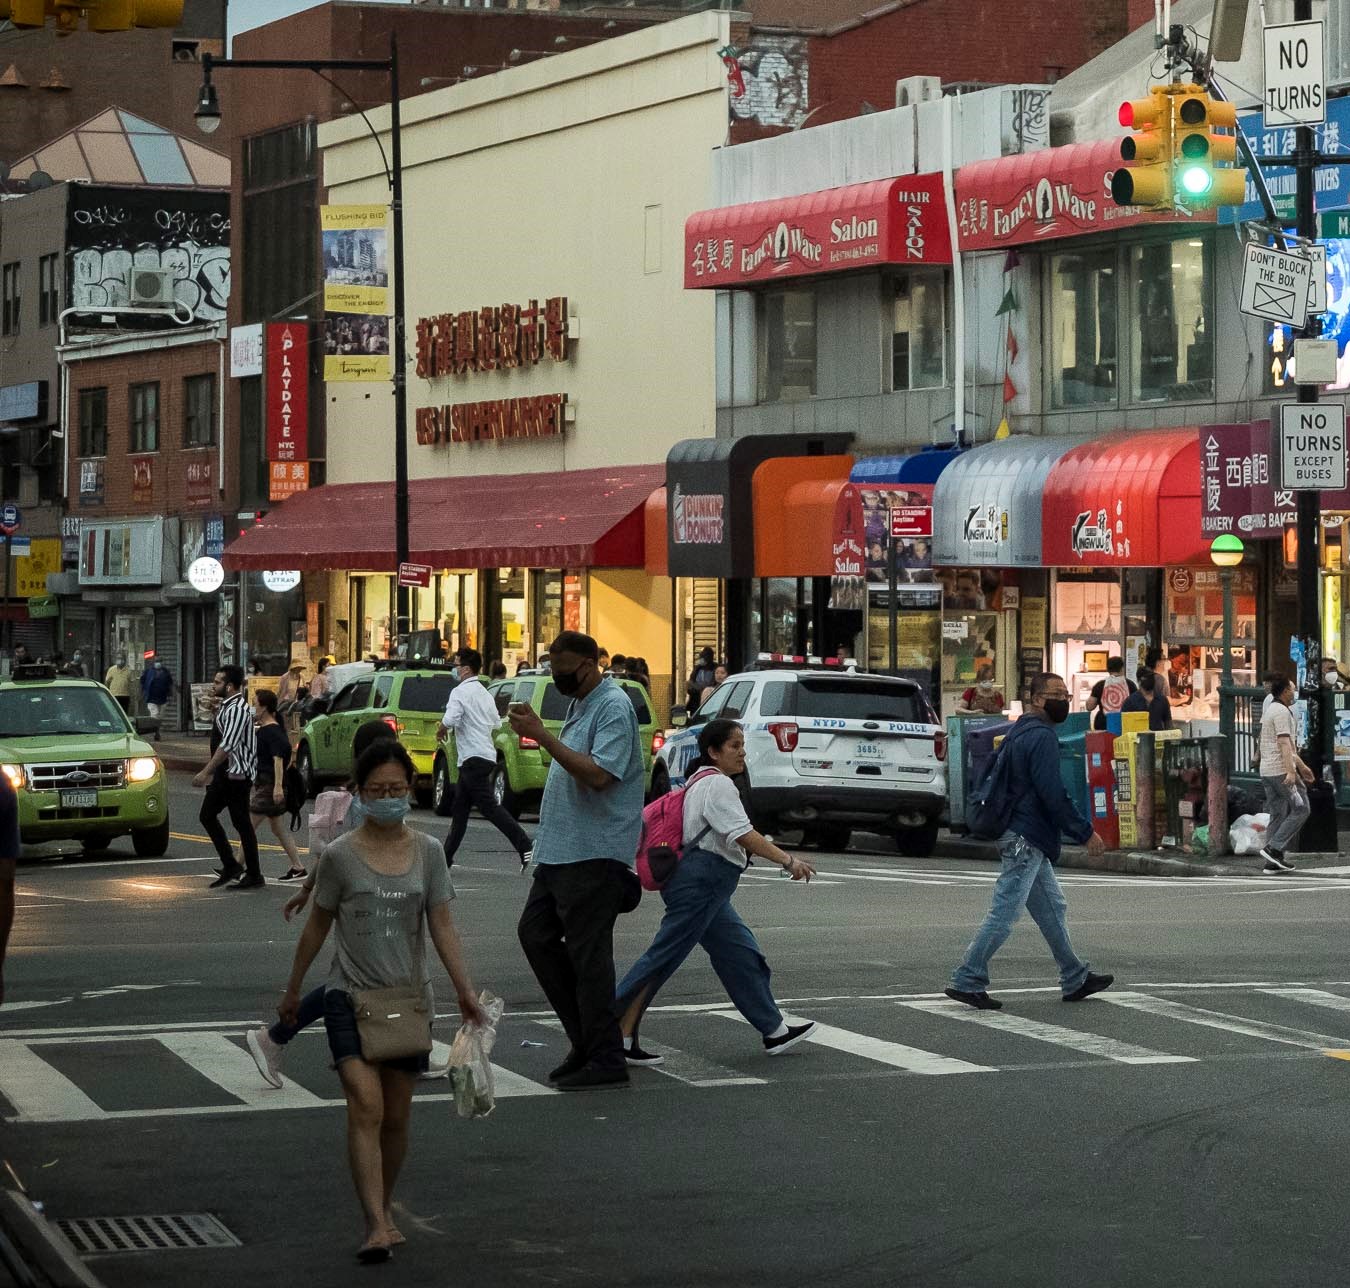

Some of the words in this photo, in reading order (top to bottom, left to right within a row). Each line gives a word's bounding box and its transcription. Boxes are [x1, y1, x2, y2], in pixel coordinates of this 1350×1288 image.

[1280, 38, 1308, 70] NO
[1268, 83, 1321, 112] TURNS
[898, 191, 930, 204] HAIR
[325, 213, 367, 221] FLUSHING
[993, 188, 1034, 236] Fancy
[1056, 184, 1096, 221] Wave
[830, 218, 878, 244] Salon
[905, 205, 925, 259] SALON
[741, 232, 775, 272] Fancy
[790, 228, 822, 262] Wave
[1251, 250, 1276, 267] DON'T
[1279, 258, 1307, 276] BLOCK
[1260, 268, 1275, 283] THE
[1279, 273, 1296, 287] BOX
[281, 339, 293, 437] PLAYDATE
[1301, 414, 1326, 430] NO
[1286, 436, 1342, 451] TURNS
[1294, 456, 1333, 466] EXCEPT
[1296, 470, 1331, 479] BUSES
[686, 494, 724, 519] DUNKIN'
[893, 516, 914, 524] Anytime
[687, 518, 724, 544] DONUTS
[835, 557, 860, 572] Salon
[813, 719, 846, 728] NYPD
[889, 723, 927, 733] POLICE
[857, 745, 877, 753] 3685
